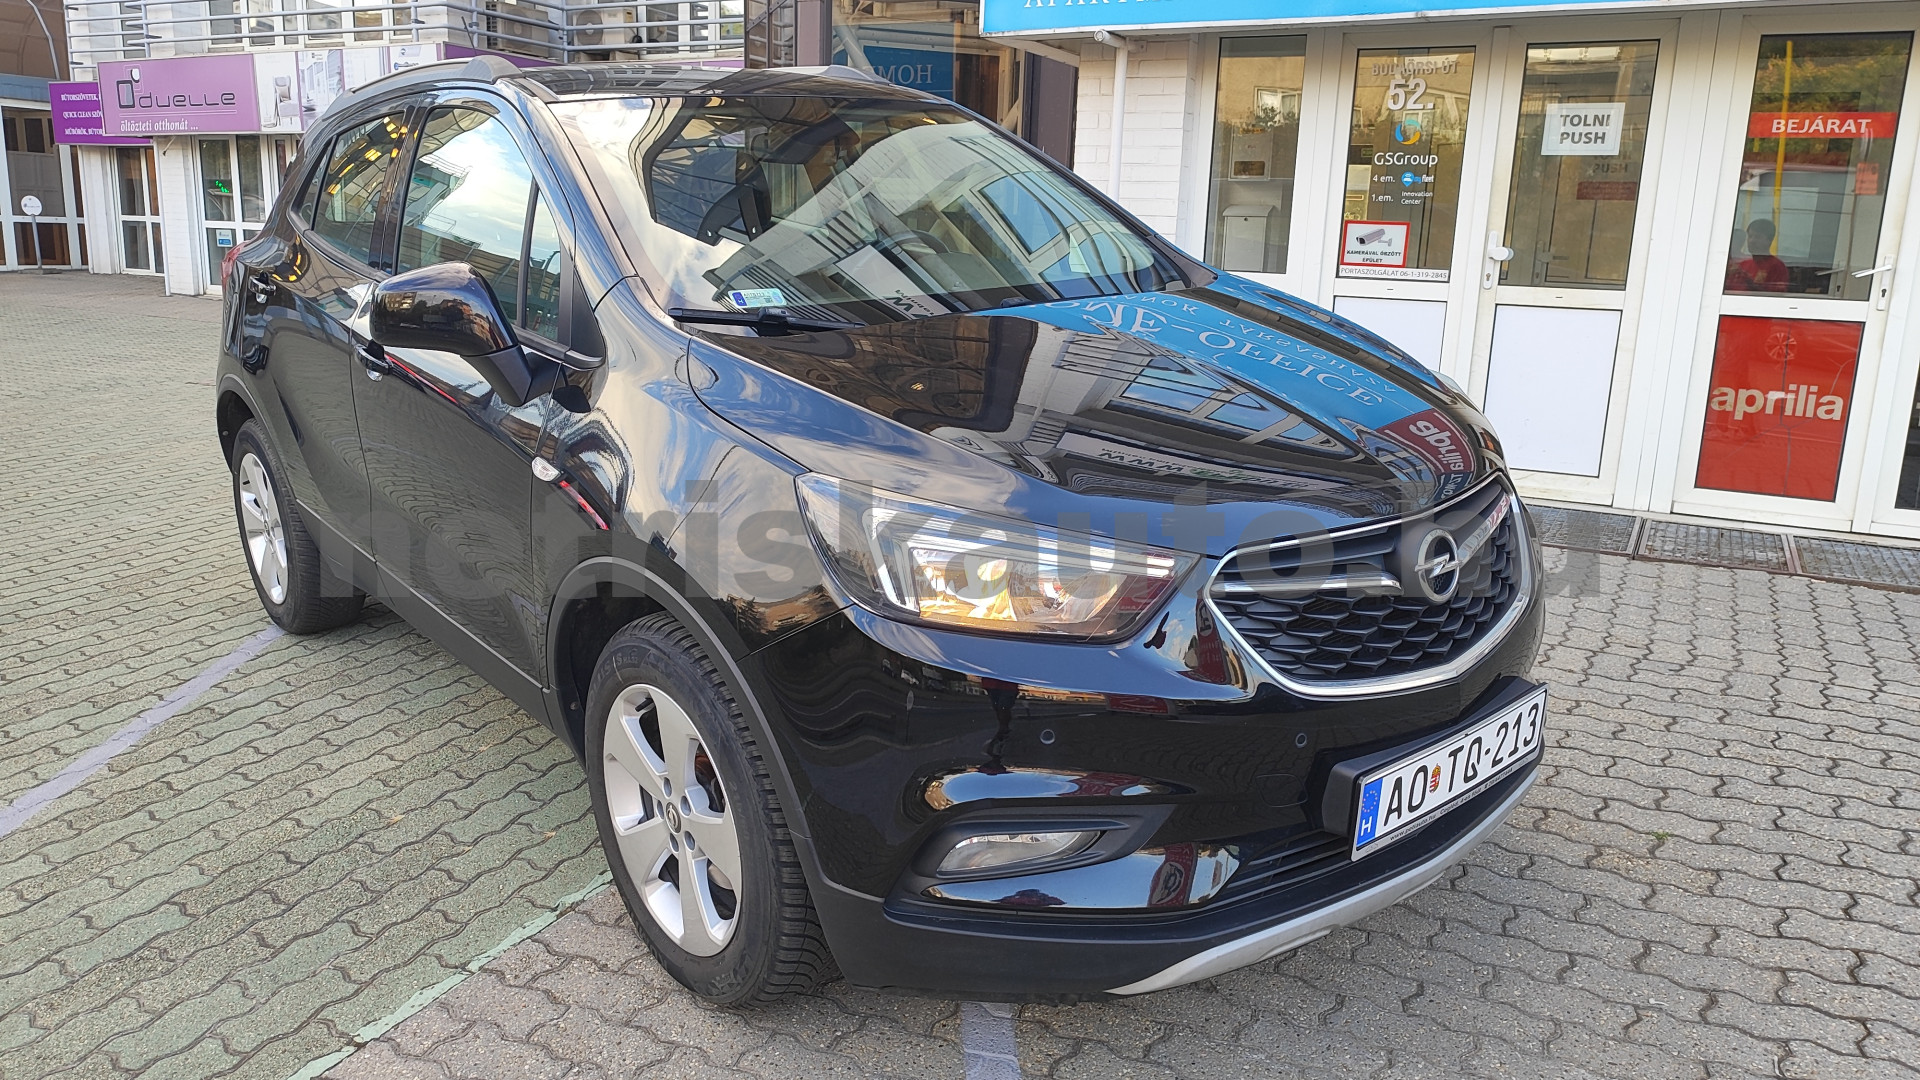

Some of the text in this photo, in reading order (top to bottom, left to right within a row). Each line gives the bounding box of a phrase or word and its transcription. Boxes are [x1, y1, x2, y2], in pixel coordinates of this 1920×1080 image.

[1387, 78, 1434, 110] 52.
[154, 119, 188, 131] otthonát
[1560, 114, 1611, 127] TOLNI
[1771, 115, 1872, 134] BEJÁRAT
[1559, 131, 1606, 145] PUSH
[1374, 152, 1438, 167] GSGroup
[1372, 174, 1378, 182] 4
[1380, 175, 1396, 183] em.
[1341, 267, 1399, 277] PORTASZOLGÁLAT
[1710, 384, 1844, 421] aprilia
[1383, 702, 1540, 827] AO TQ-213
[1360, 817, 1373, 837] H
